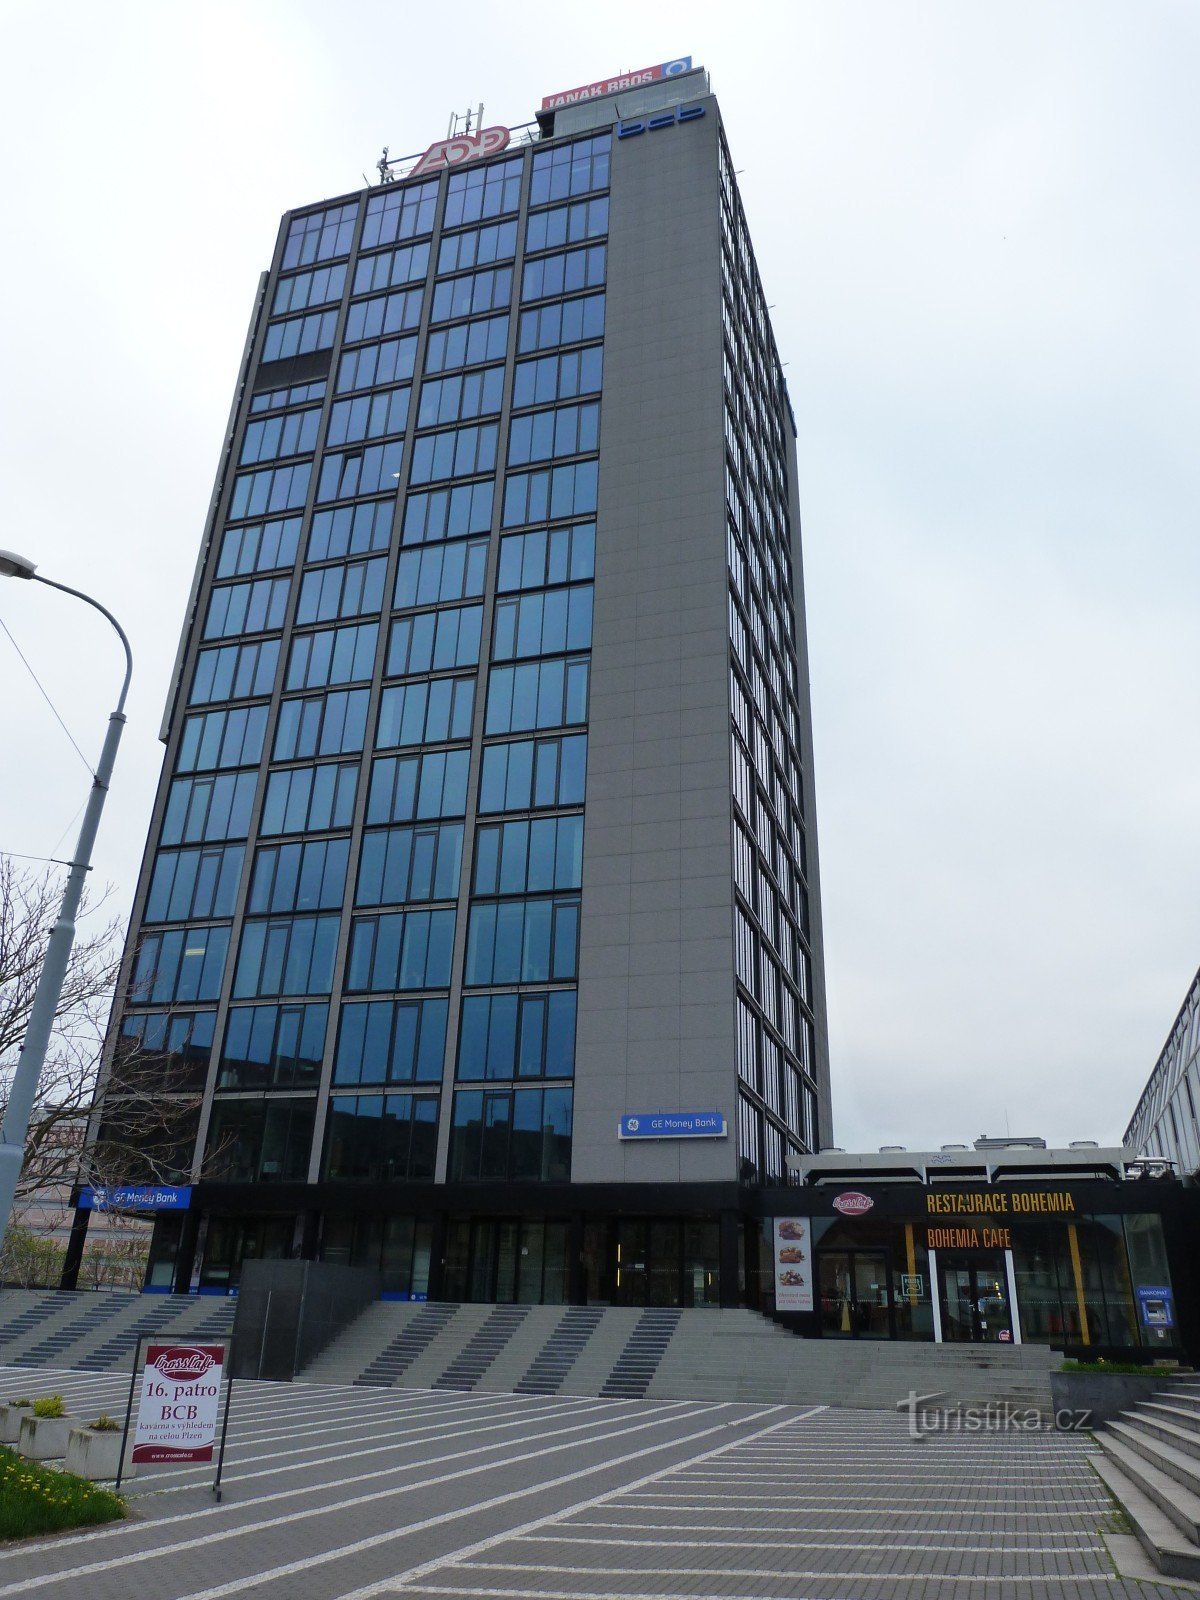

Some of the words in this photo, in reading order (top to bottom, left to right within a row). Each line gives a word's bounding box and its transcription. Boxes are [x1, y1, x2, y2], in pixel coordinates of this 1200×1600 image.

[607, 71, 653, 93] BROS
[412, 128, 507, 177] ADP
[652, 1120, 663, 1128] GE
[665, 1119, 693, 1129] Money
[695, 1118, 717, 1127] Bank
[156, 1192, 177, 1203] Bank
[926, 1193, 1008, 1213] RESTAURACE
[1011, 1192, 1075, 1212] BOHEMIA
[928, 1229, 979, 1248] BOHEMIA
[983, 1228, 1012, 1248] CAFE
[146, 1382, 168, 1397] 16.
[173, 1382, 218, 1401] patro
[160, 1405, 198, 1420] BCB
